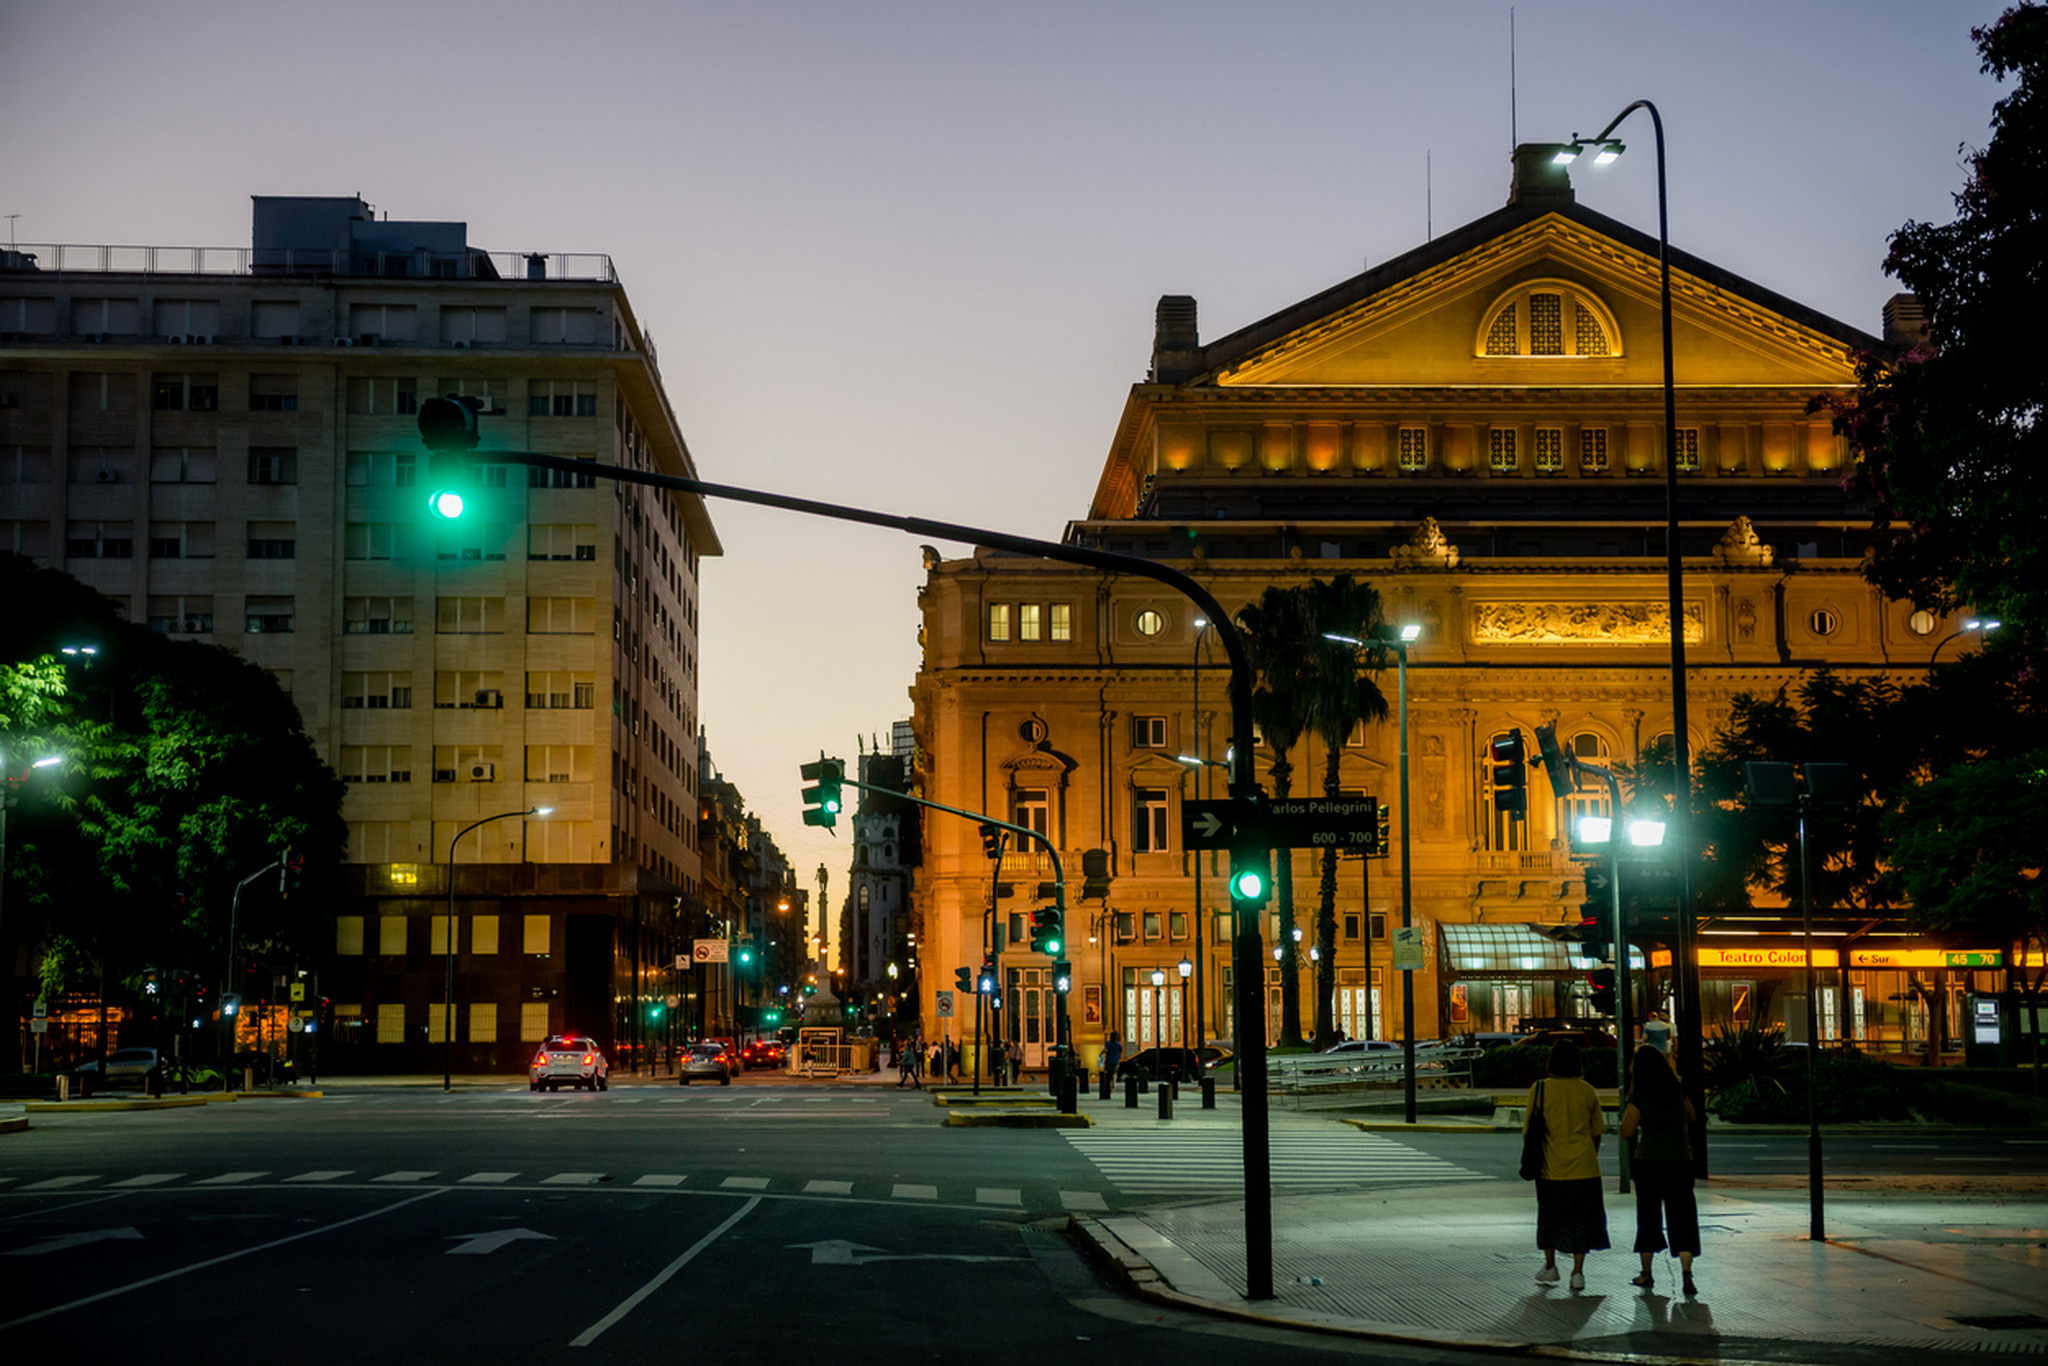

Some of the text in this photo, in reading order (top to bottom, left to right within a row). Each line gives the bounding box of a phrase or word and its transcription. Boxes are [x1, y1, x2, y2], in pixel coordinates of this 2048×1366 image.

[1268, 801, 1373, 816] arlos Pellegrini
[1312, 832, 1336, 844] 600
[1348, 831, 1373, 844] 700
[1719, 951, 1763, 963] Teatro
[1871, 955, 1889, 964] Sur
[1952, 954, 1995, 965] 45 70
